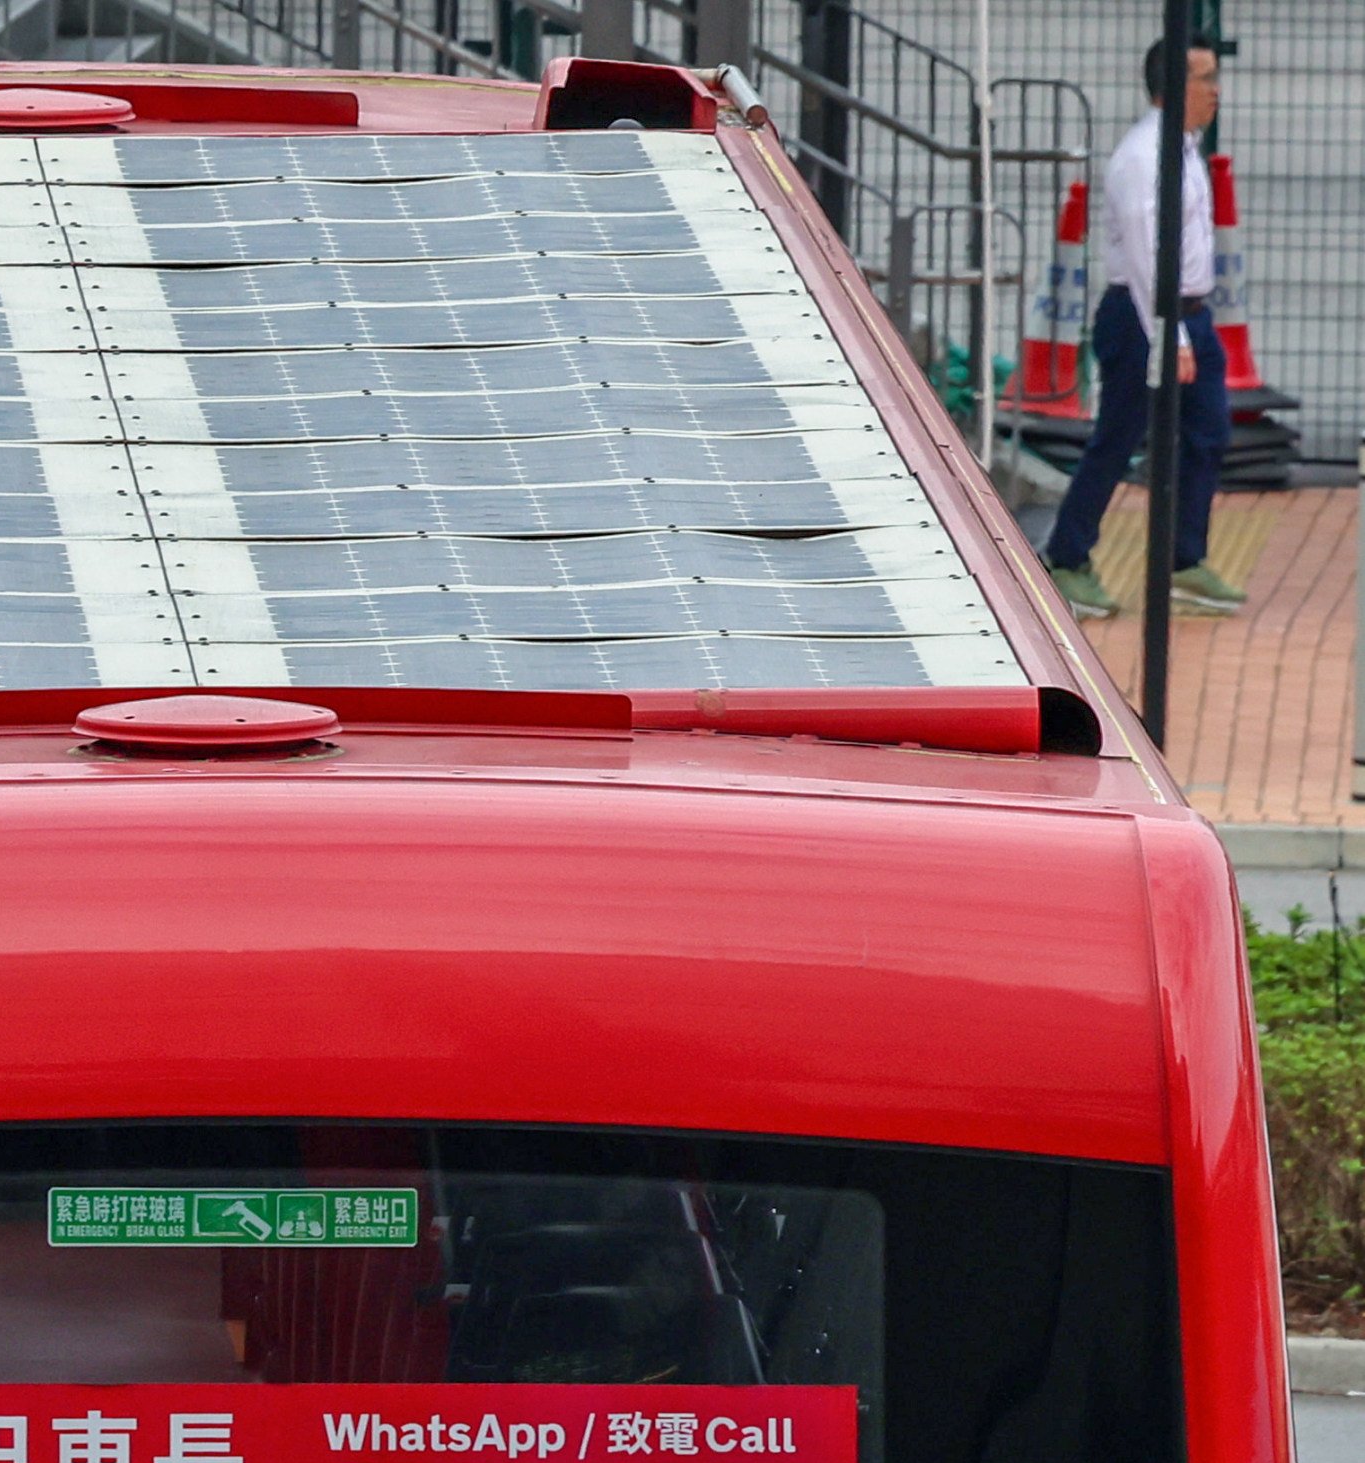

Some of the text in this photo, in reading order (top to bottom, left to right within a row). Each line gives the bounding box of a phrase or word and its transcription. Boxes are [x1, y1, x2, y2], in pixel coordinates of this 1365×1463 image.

[55, 1195, 186, 1223] 緊急時打碎玻璃
[334, 1196, 408, 1224] 緊急出口
[56, 1225, 185, 1237] IN EMERGENCY BREAK GLASS
[334, 1226, 408, 1238] EMERGENCY EXIT
[322, 1411, 566, 1460] WhatsApp
